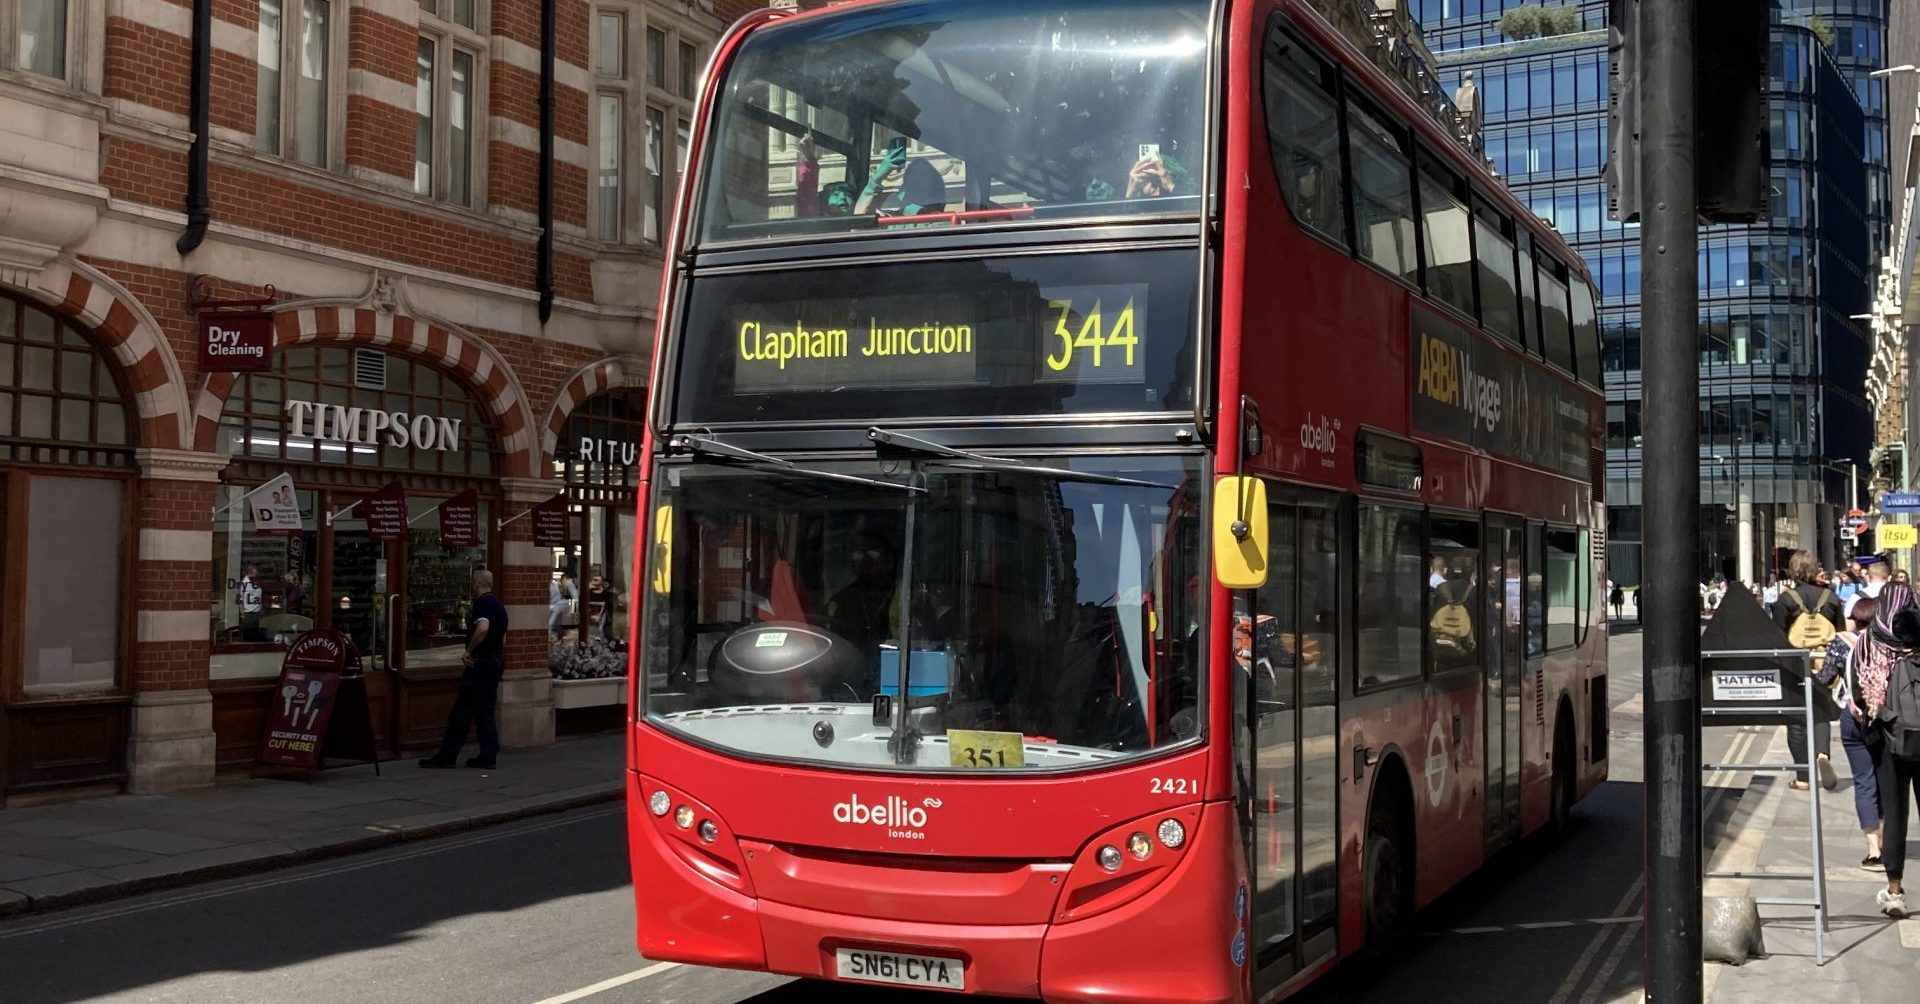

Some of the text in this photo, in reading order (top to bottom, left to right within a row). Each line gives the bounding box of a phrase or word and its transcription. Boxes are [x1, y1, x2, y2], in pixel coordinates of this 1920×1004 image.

[208, 326, 241, 346] Dry
[740, 316, 971, 369] Clapham Junction
[1046, 295, 1139, 372] 344
[208, 343, 264, 358] Cleaning
[1418, 332, 1501, 432] ABBA Voyage
[285, 400, 462, 452] TIMPSON
[1300, 411, 1336, 454] abellio
[580, 436, 644, 466] RITU
[1884, 528, 1909, 541] itsu
[296, 637, 341, 657] TIMPSON
[1718, 675, 1775, 684] HATTON
[268, 739, 315, 752] CUT HERE!
[270, 730, 318, 742] SECURITY KEYS
[963, 747, 1005, 768] 351
[1149, 778, 1198, 796] 2421
[832, 793, 928, 829] abellio
[888, 829, 925, 840] london
[849, 952, 951, 984] SN61 CYA
